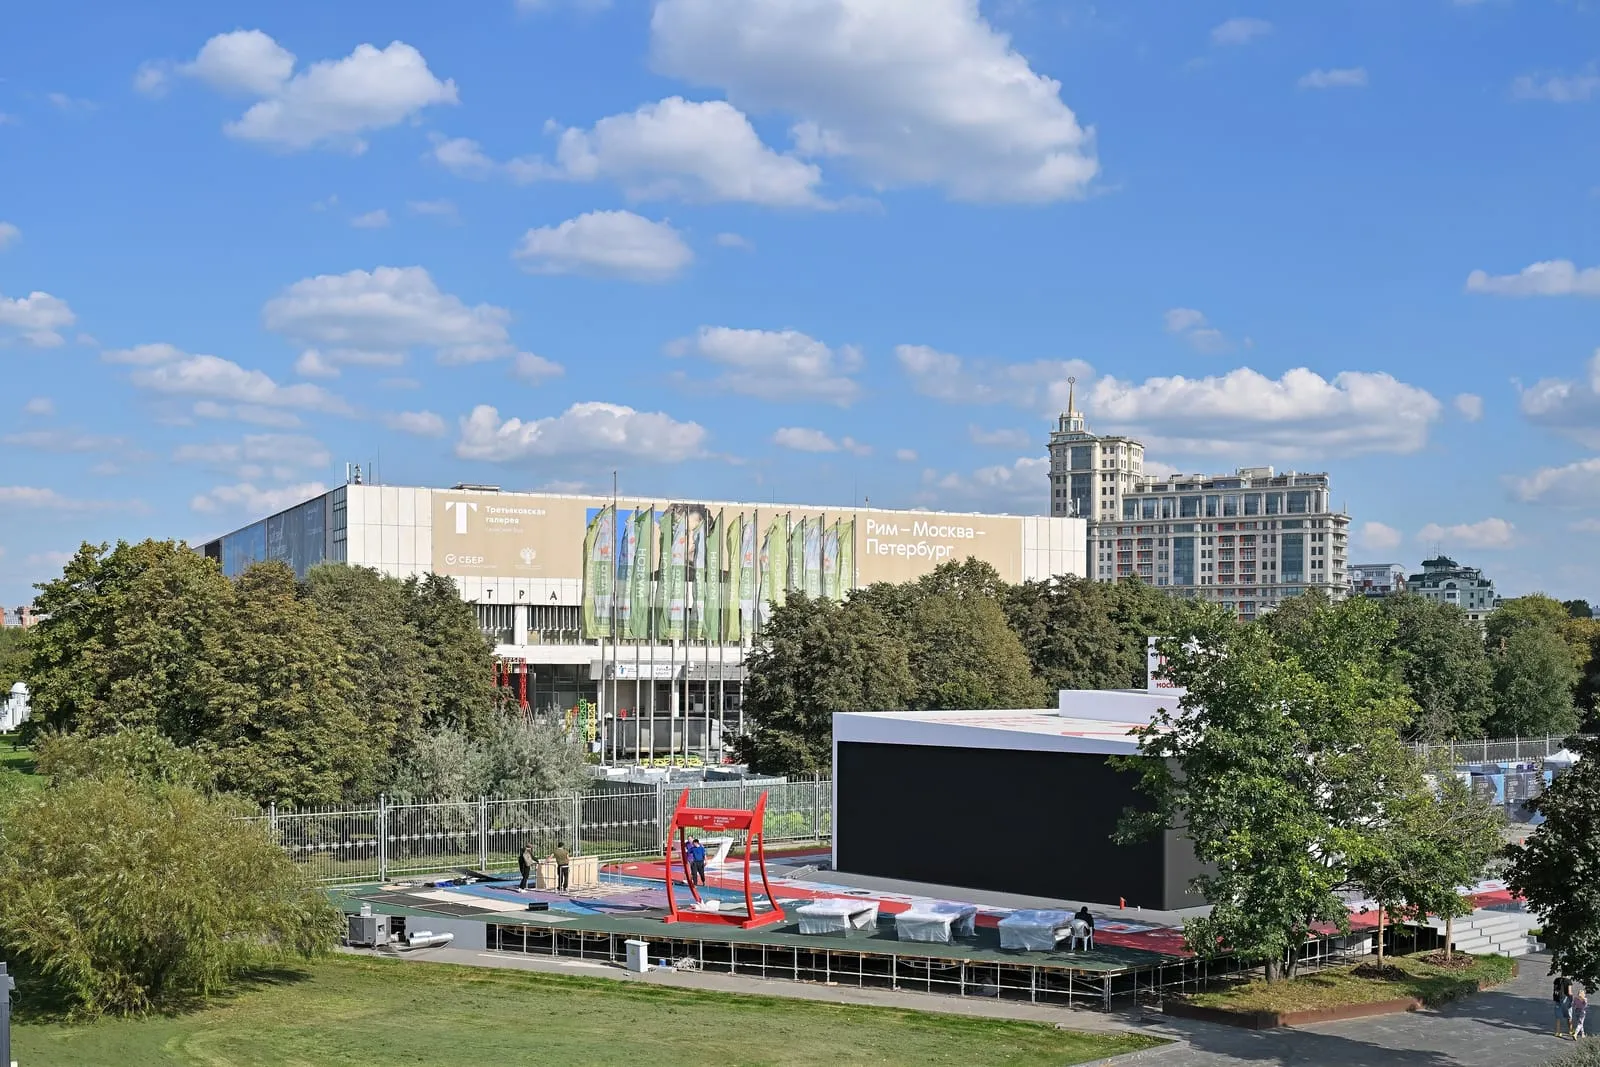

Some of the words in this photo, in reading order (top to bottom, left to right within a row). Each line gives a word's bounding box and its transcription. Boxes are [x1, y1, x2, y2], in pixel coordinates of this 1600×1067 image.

[485, 505, 546, 516] Третьяковская
[486, 517, 520, 525] галерея
[866, 519, 898, 536] Рим
[913, 521, 974, 539] Москва
[866, 539, 954, 560] Петербург
[458, 555, 484, 564] СБЕР
